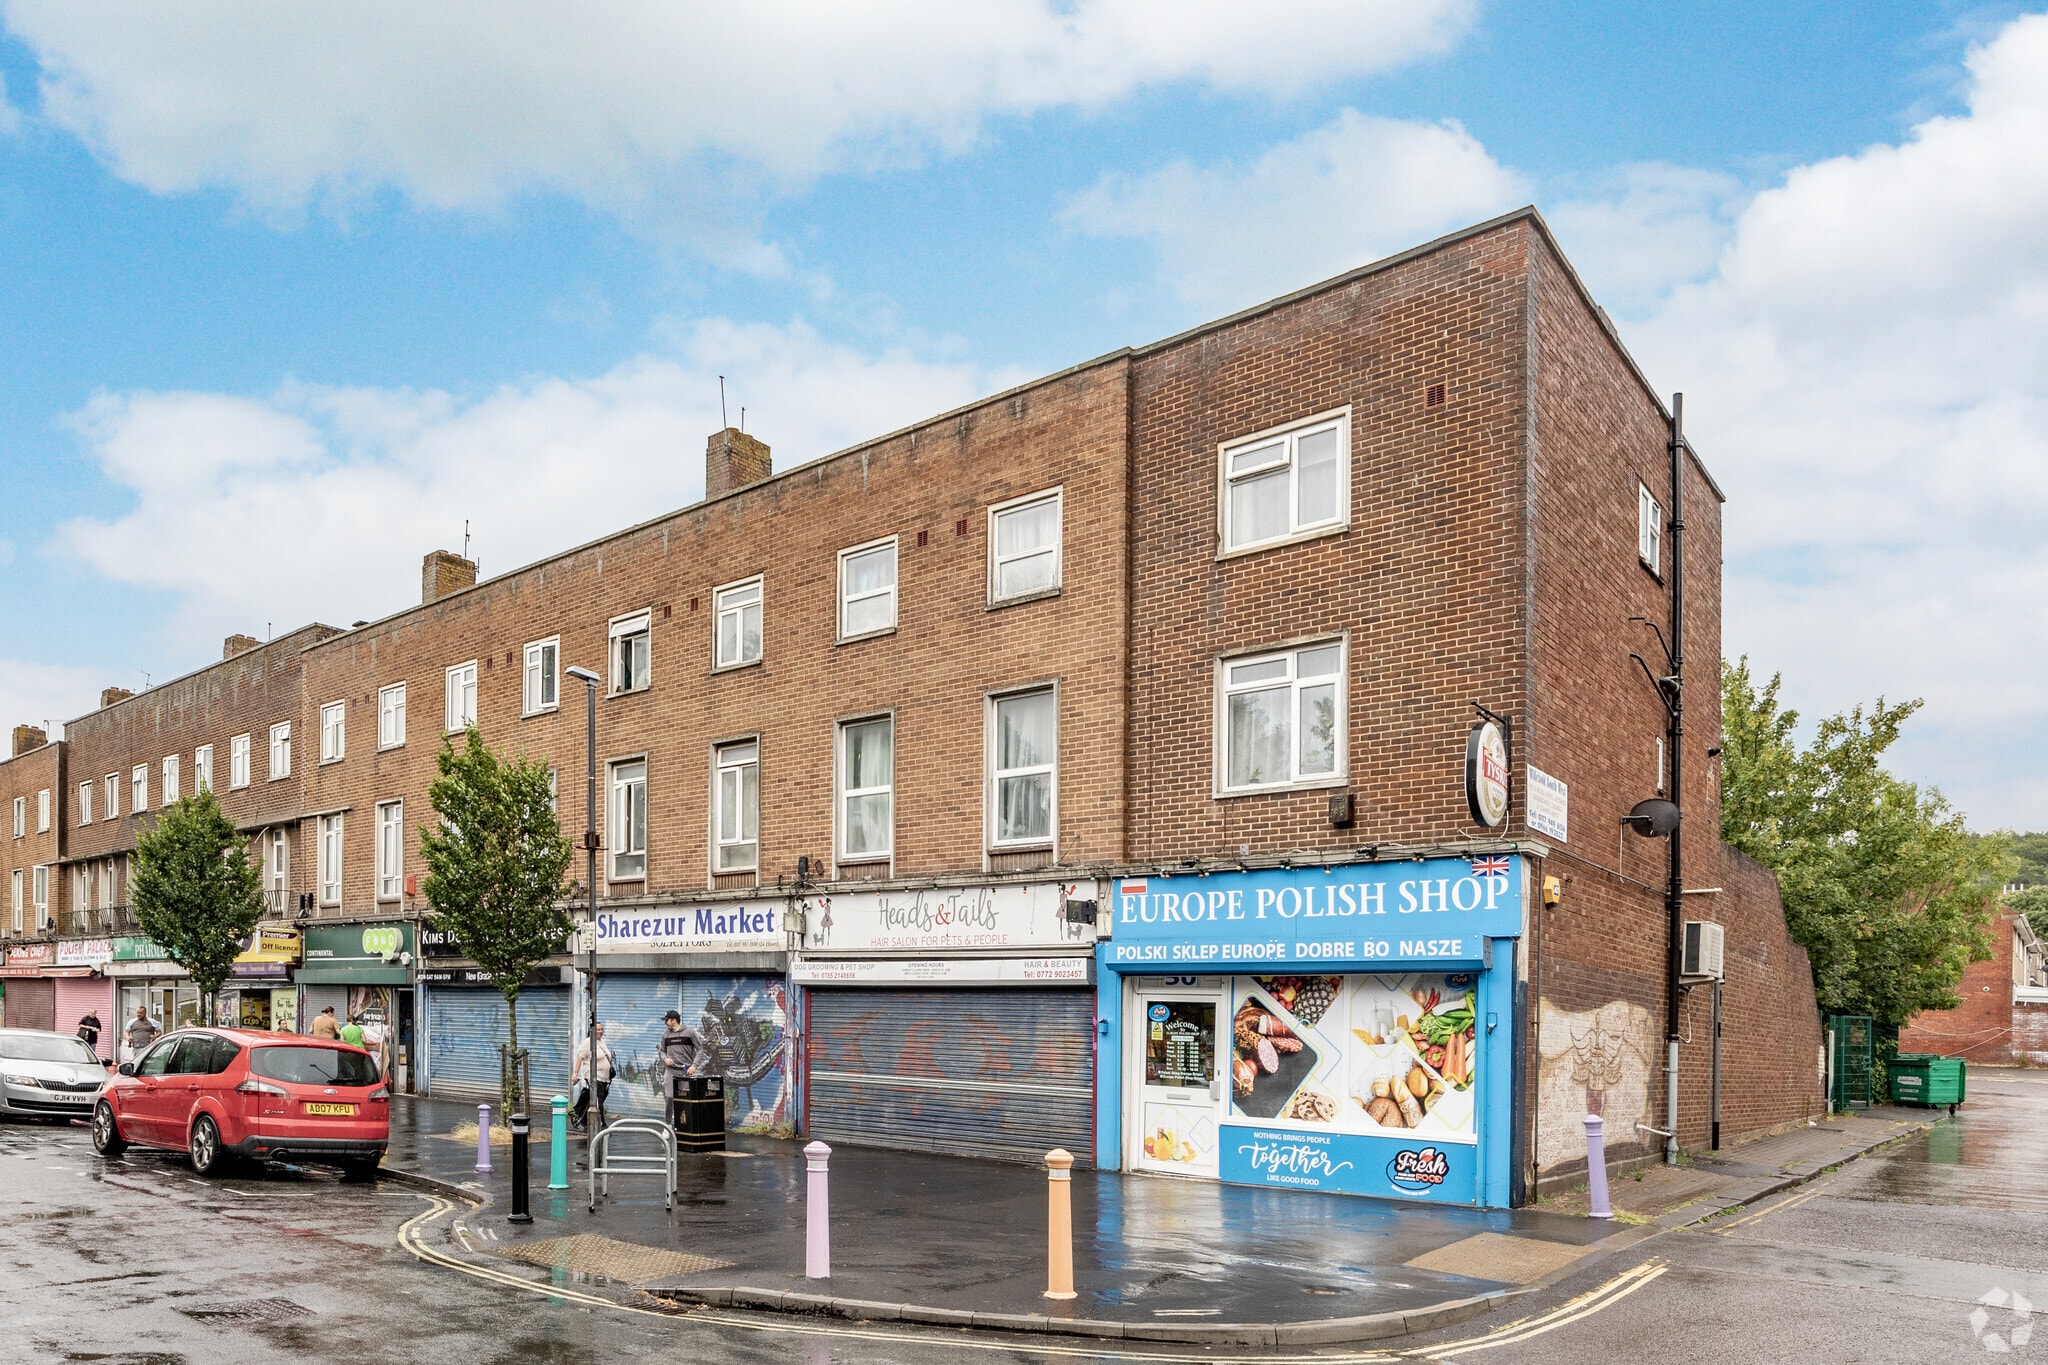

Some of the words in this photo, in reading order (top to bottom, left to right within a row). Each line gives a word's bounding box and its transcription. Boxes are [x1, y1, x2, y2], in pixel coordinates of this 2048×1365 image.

[1120, 889, 1246, 923] EUROPE
[1255, 882, 1387, 919] POLISH
[1398, 876, 1509, 914] SHOP
[597, 914, 686, 939] Sharezur
[694, 907, 775, 935] Market
[262, 931, 289, 939] Premier
[365, 934, 395, 947] FOOD
[422, 930, 444, 944] KIMS
[870, 937, 889, 947] HAIR
[891, 936, 918, 946] SALON
[921, 936, 938, 945] FOR
[940, 935, 962, 946] PETS
[964, 936, 972, 945] &
[973, 934, 1008, 945] PEOPLE
[274, 943, 299, 951] licence
[306, 949, 334, 957] CONTINENTAL
[1116, 945, 1167, 960] POLSKI
[1172, 944, 1219, 960] SKLEP
[1222, 943, 1286, 959] EUROPE
[1295, 942, 1355, 958] DOBRE
[1363, 941, 1390, 957] BO
[1399, 939, 1462, 956] NASZE
[1165, 1020, 1199, 1032] Welcome
[334, 1105, 350, 1114] KFU
[1254, 1132, 1282, 1140] NOTHING
[1283, 1134, 1306, 1143] BRINGS
[1307, 1136, 1331, 1145] PEOPLE
[1238, 1141, 1354, 1176] together
[1397, 1151, 1447, 1175] Fresh
[1266, 1174, 1280, 1182] LIKE
[1280, 1175, 1300, 1184] GOOD
[1300, 1177, 1320, 1186] FOOD
[1416, 1173, 1443, 1184] FOOD
